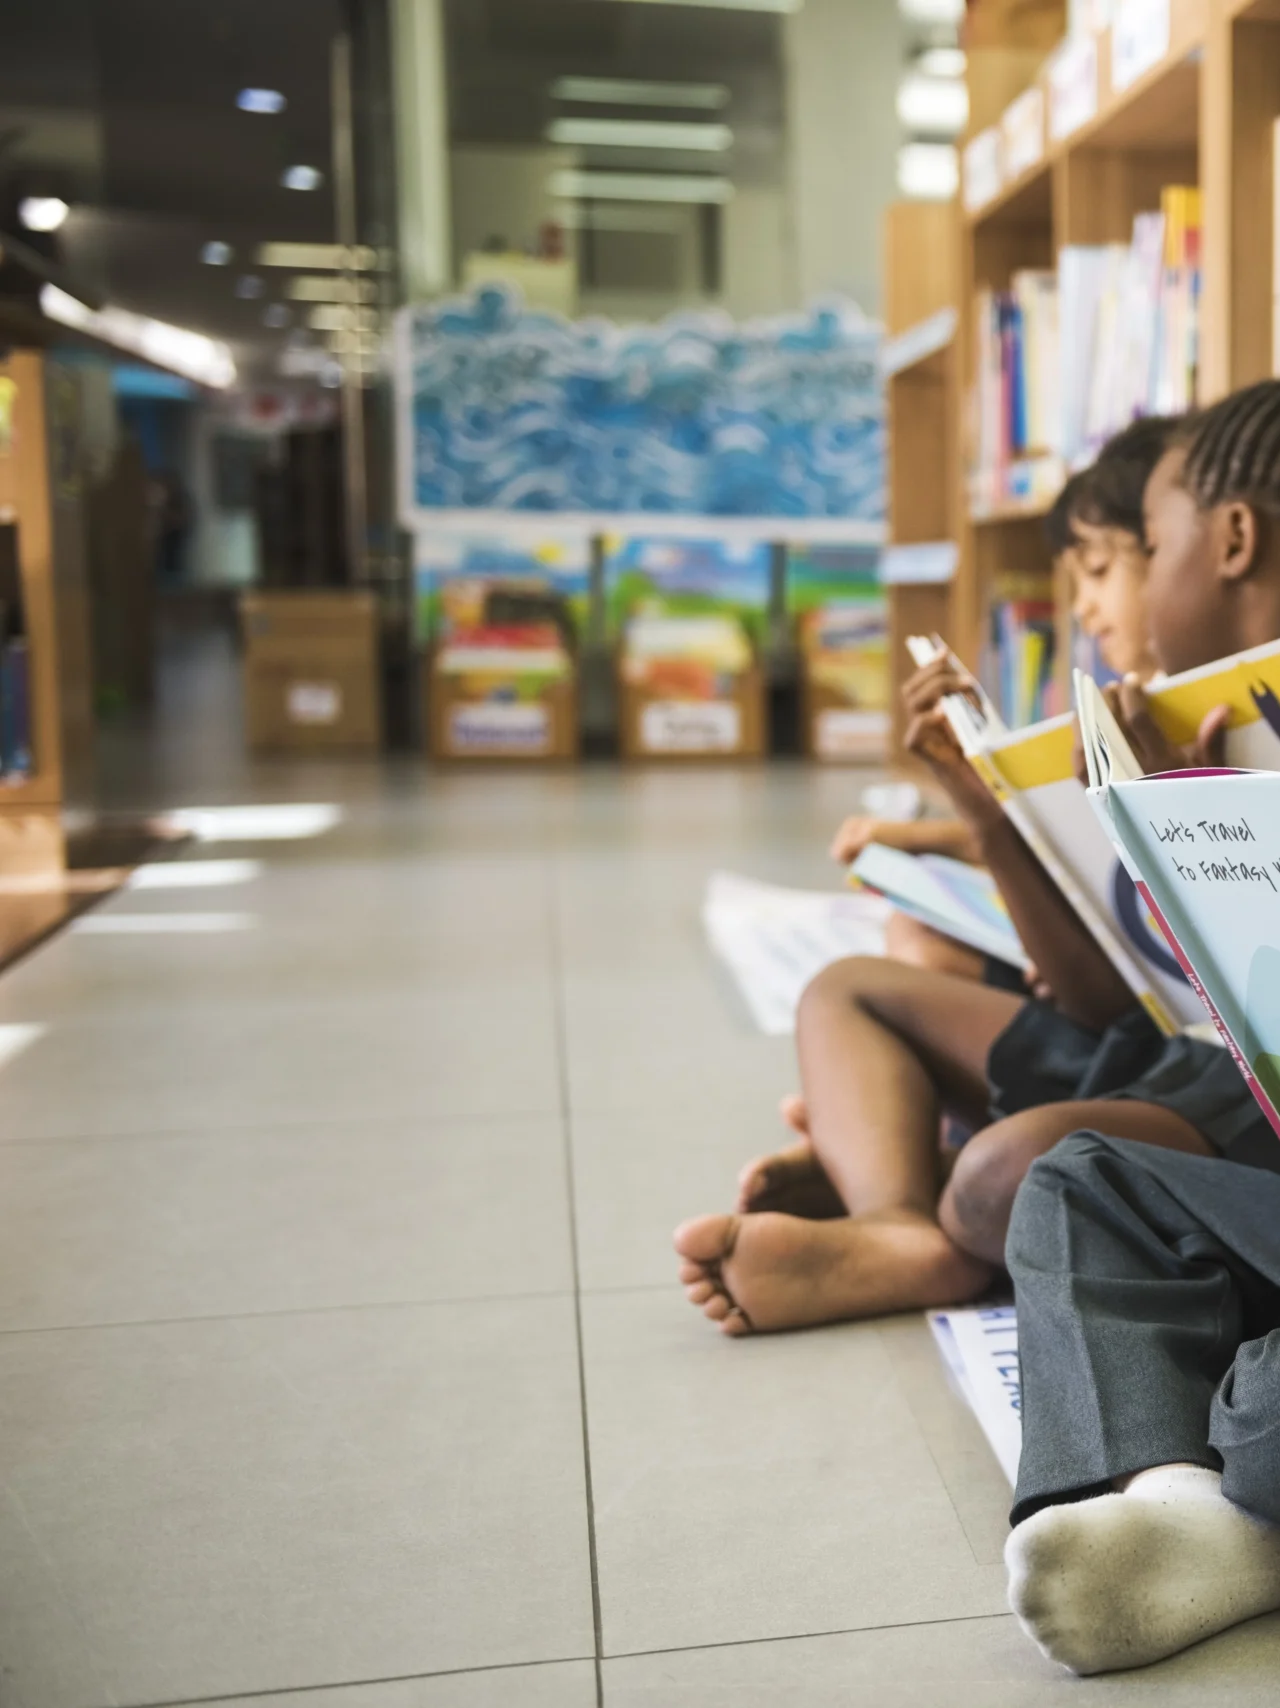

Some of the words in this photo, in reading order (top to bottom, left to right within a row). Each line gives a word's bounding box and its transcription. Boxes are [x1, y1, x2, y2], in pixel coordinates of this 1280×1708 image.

[1150, 818, 1194, 843] Let's
[1197, 817, 1256, 842] Travel
[1172, 856, 1196, 882] to
[1199, 856, 1278, 892] Fantasy
